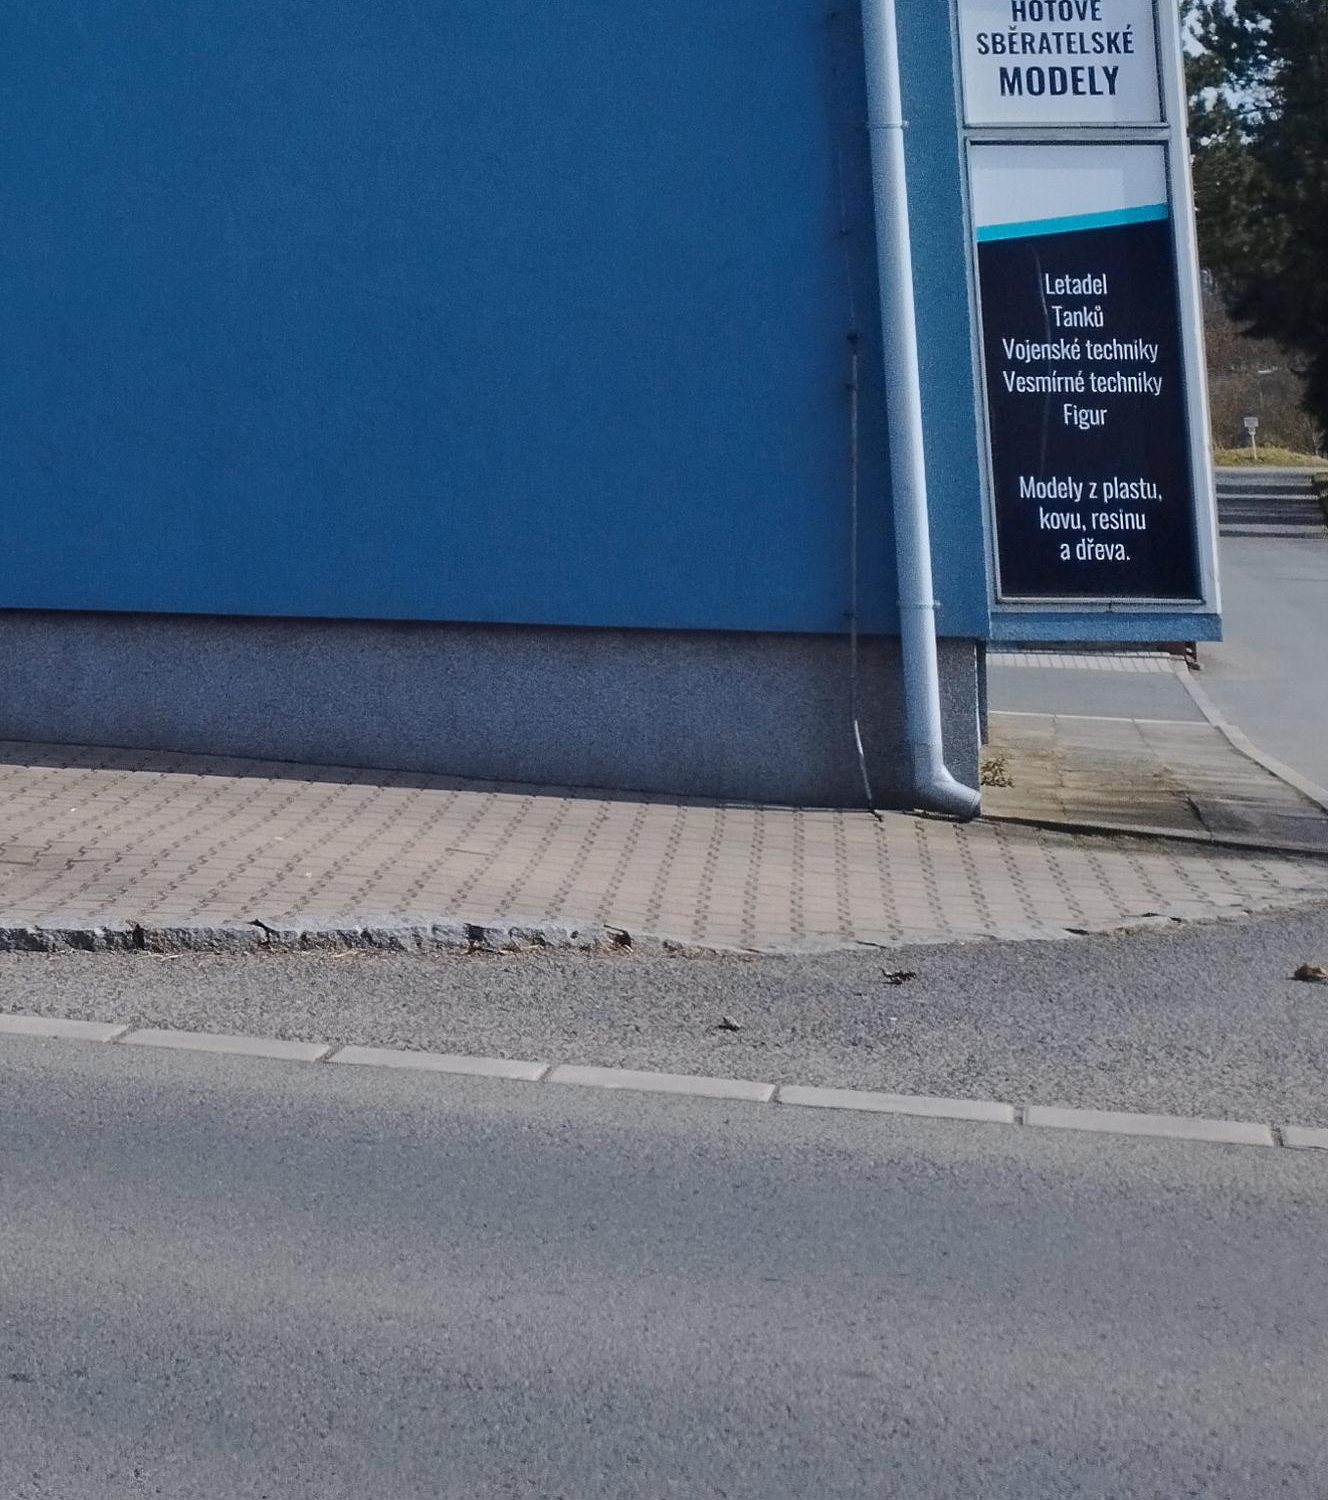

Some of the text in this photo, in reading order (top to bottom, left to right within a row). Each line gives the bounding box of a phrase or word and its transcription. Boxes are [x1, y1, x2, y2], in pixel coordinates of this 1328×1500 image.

[976, 24, 1135, 55] SBĚRATELSKÉ
[999, 65, 1120, 97] MODELY
[1045, 273, 1108, 295] Letadel
[1052, 305, 1104, 328] Tanků
[1002, 337, 1158, 363] Vojenské techniky
[1002, 370, 1163, 396] Vesmírné techniky
[1063, 404, 1107, 430] Figur
[1019, 476, 1163, 503] Modely z plastu,
[1040, 507, 1146, 533] kovu, resinu
[1060, 538, 1131, 561] a dřeva.
